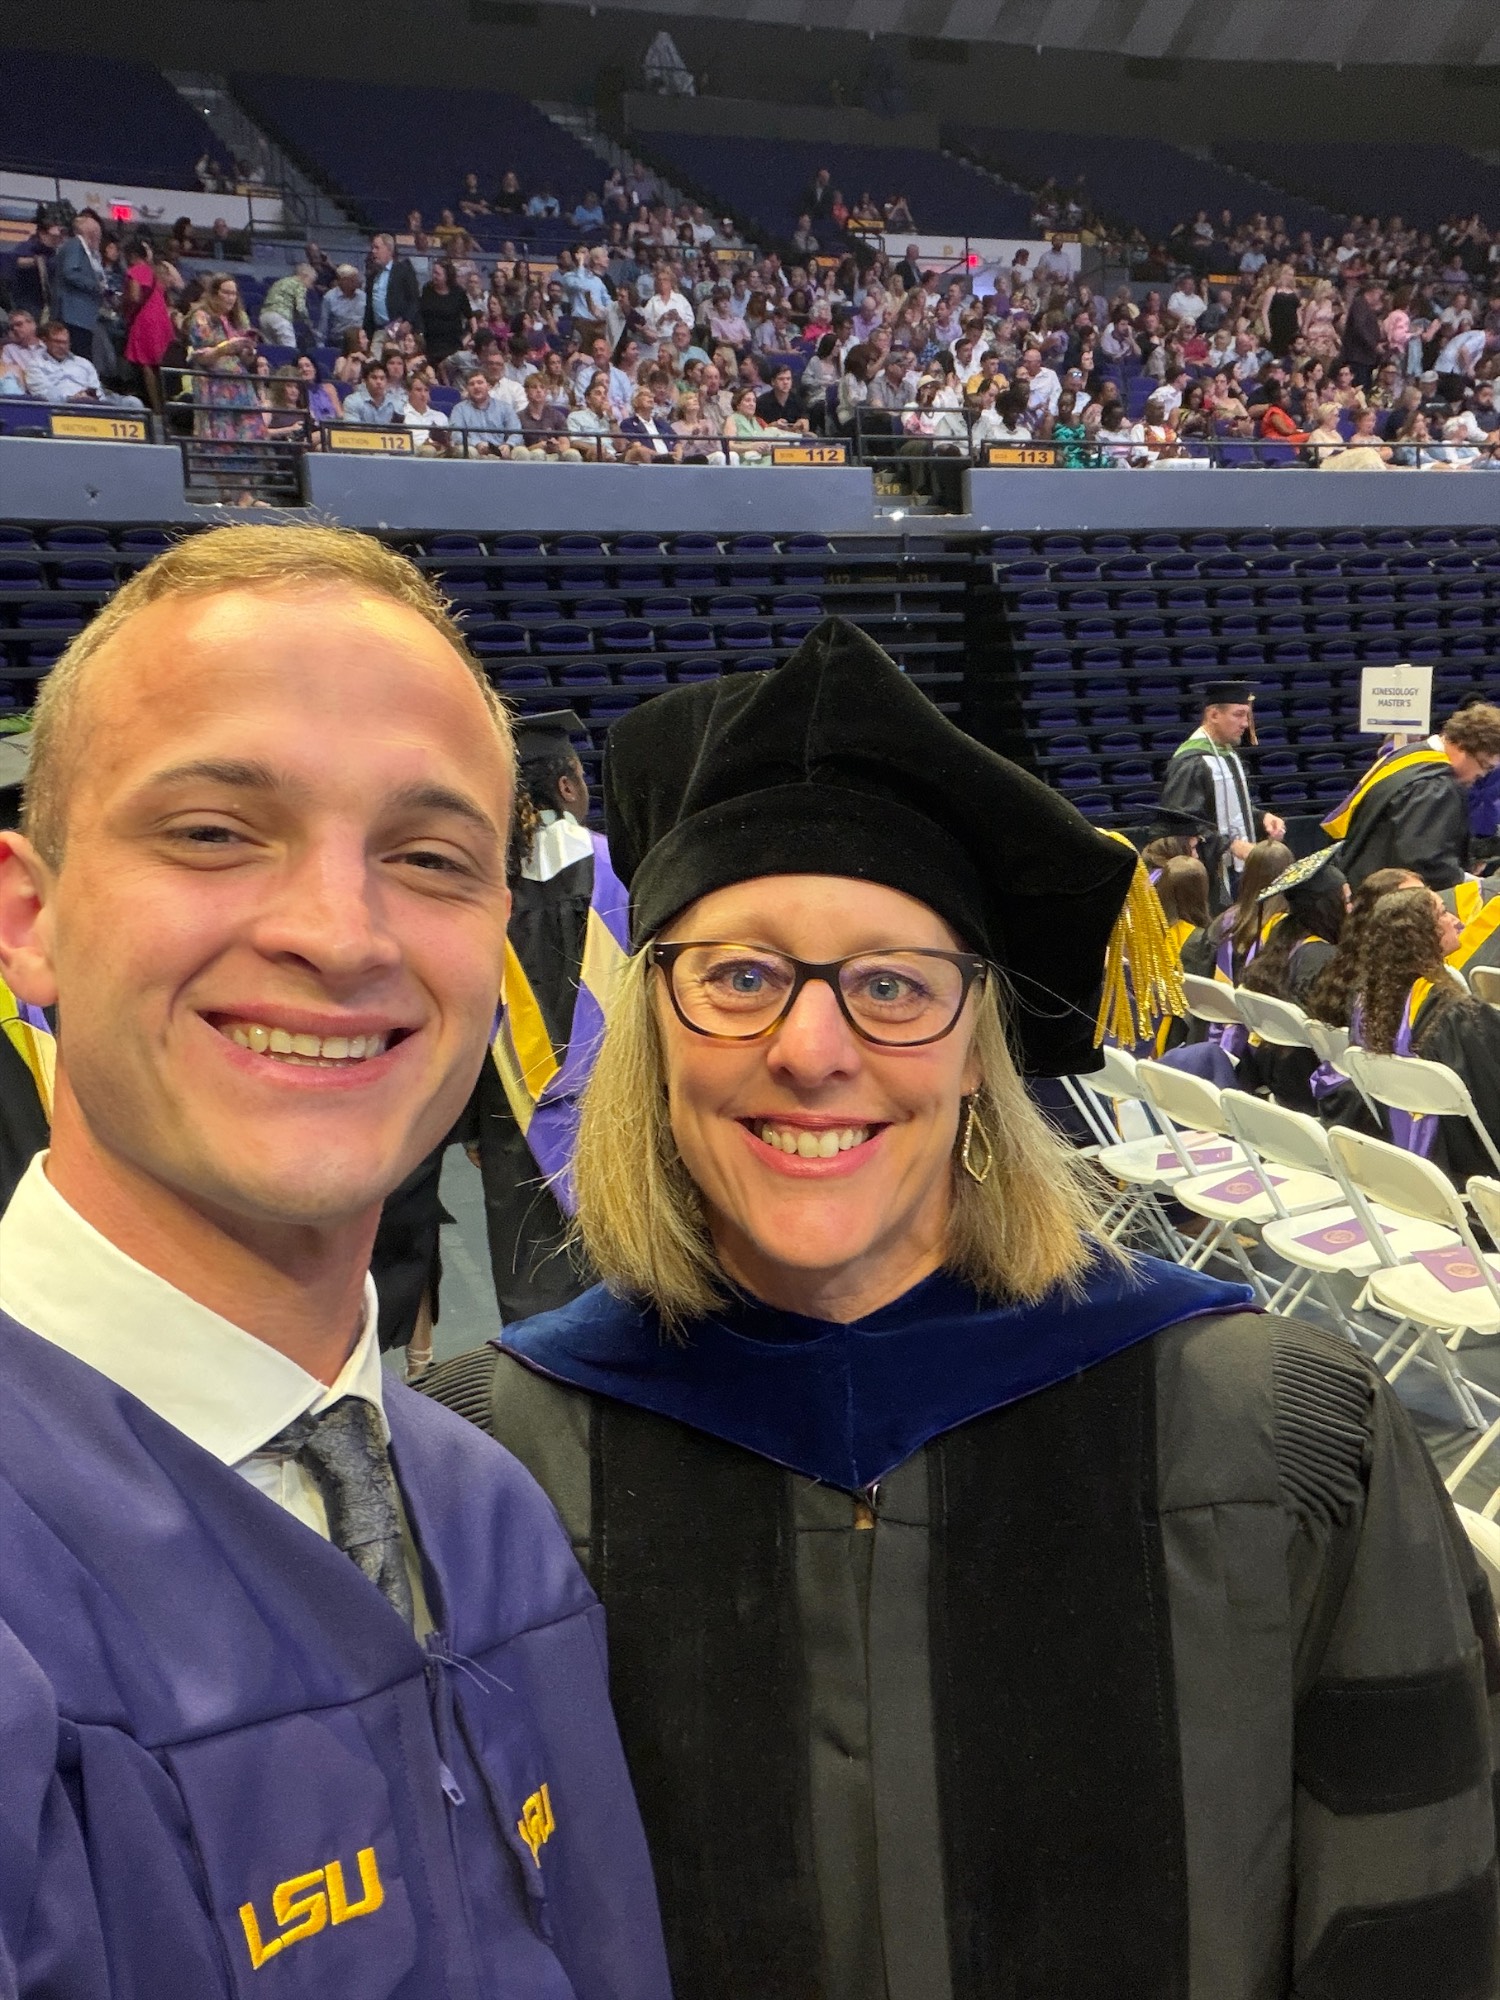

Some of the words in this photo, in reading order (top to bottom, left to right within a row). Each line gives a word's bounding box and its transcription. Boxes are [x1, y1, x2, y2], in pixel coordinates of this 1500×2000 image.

[111, 423, 138, 437] 112
[381, 437, 404, 449] 112
[806, 449, 838, 461] 112
[1018, 451, 1047, 463] 113
[1372, 688, 1419, 696] KINESIOLOGY
[1378, 700, 1412, 708] MASTER'S
[239, 1847, 385, 1970] LSU
